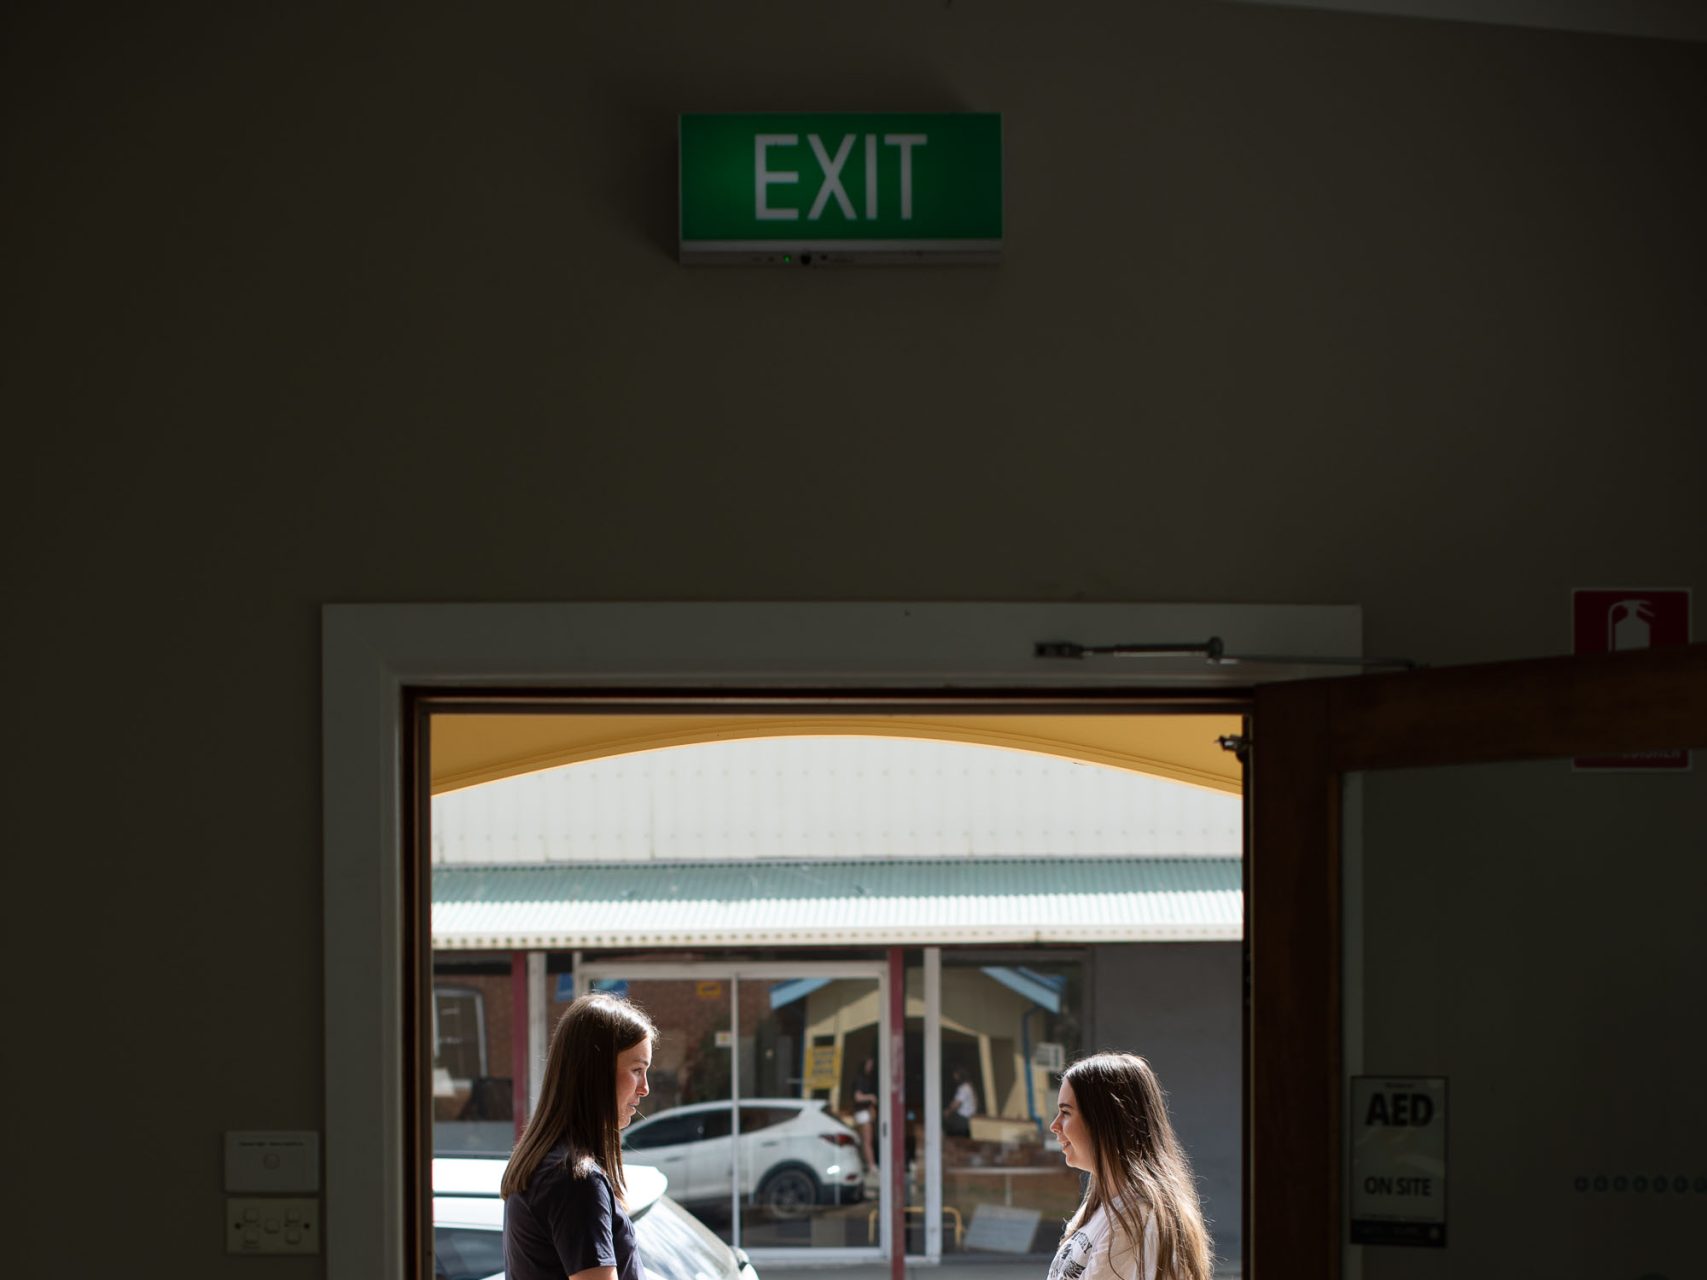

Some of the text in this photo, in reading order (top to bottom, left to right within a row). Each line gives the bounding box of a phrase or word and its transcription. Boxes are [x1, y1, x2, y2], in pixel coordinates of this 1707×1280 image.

[755, 133, 928, 221] EXIT
[1365, 1092, 1434, 1127] AED
[1364, 1176, 1432, 1196] ON SITE
